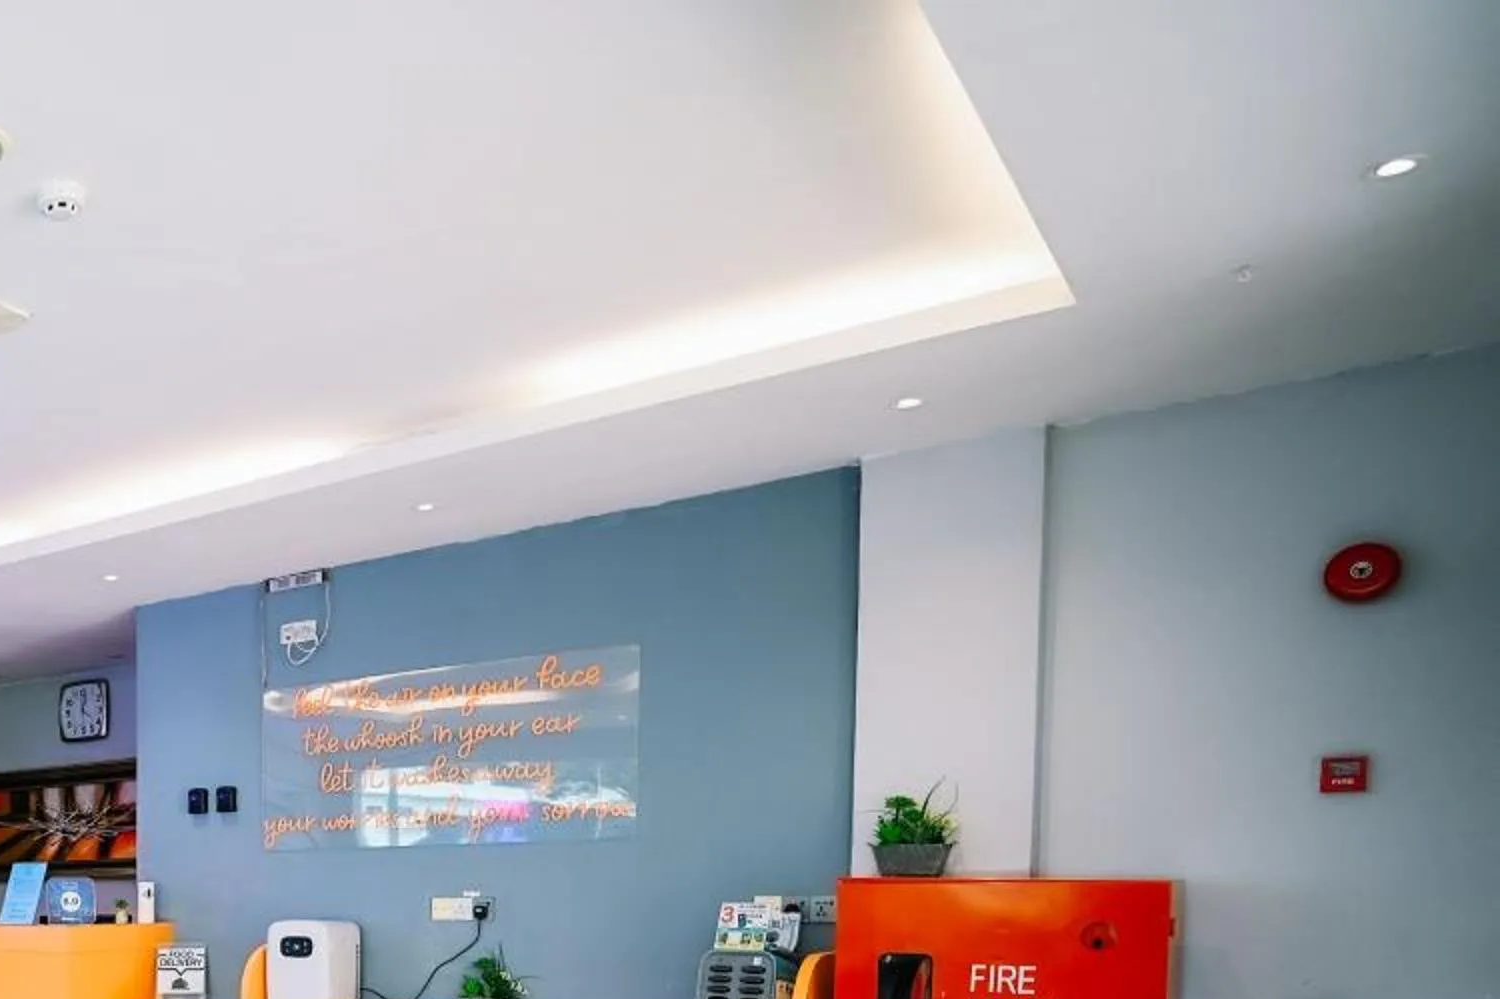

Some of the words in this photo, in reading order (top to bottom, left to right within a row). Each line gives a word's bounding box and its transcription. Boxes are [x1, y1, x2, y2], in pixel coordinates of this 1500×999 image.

[460, 675, 528, 717] your
[535, 655, 603, 690] face
[302, 724, 339, 756] the
[345, 715, 425, 751] whoosh
[432, 723, 454, 744] in
[457, 718, 524, 758] your
[531, 713, 581, 735] ear
[320, 752, 354, 793] let
[264, 814, 317, 849] your
[969, 963, 1038, 996] FIRE
